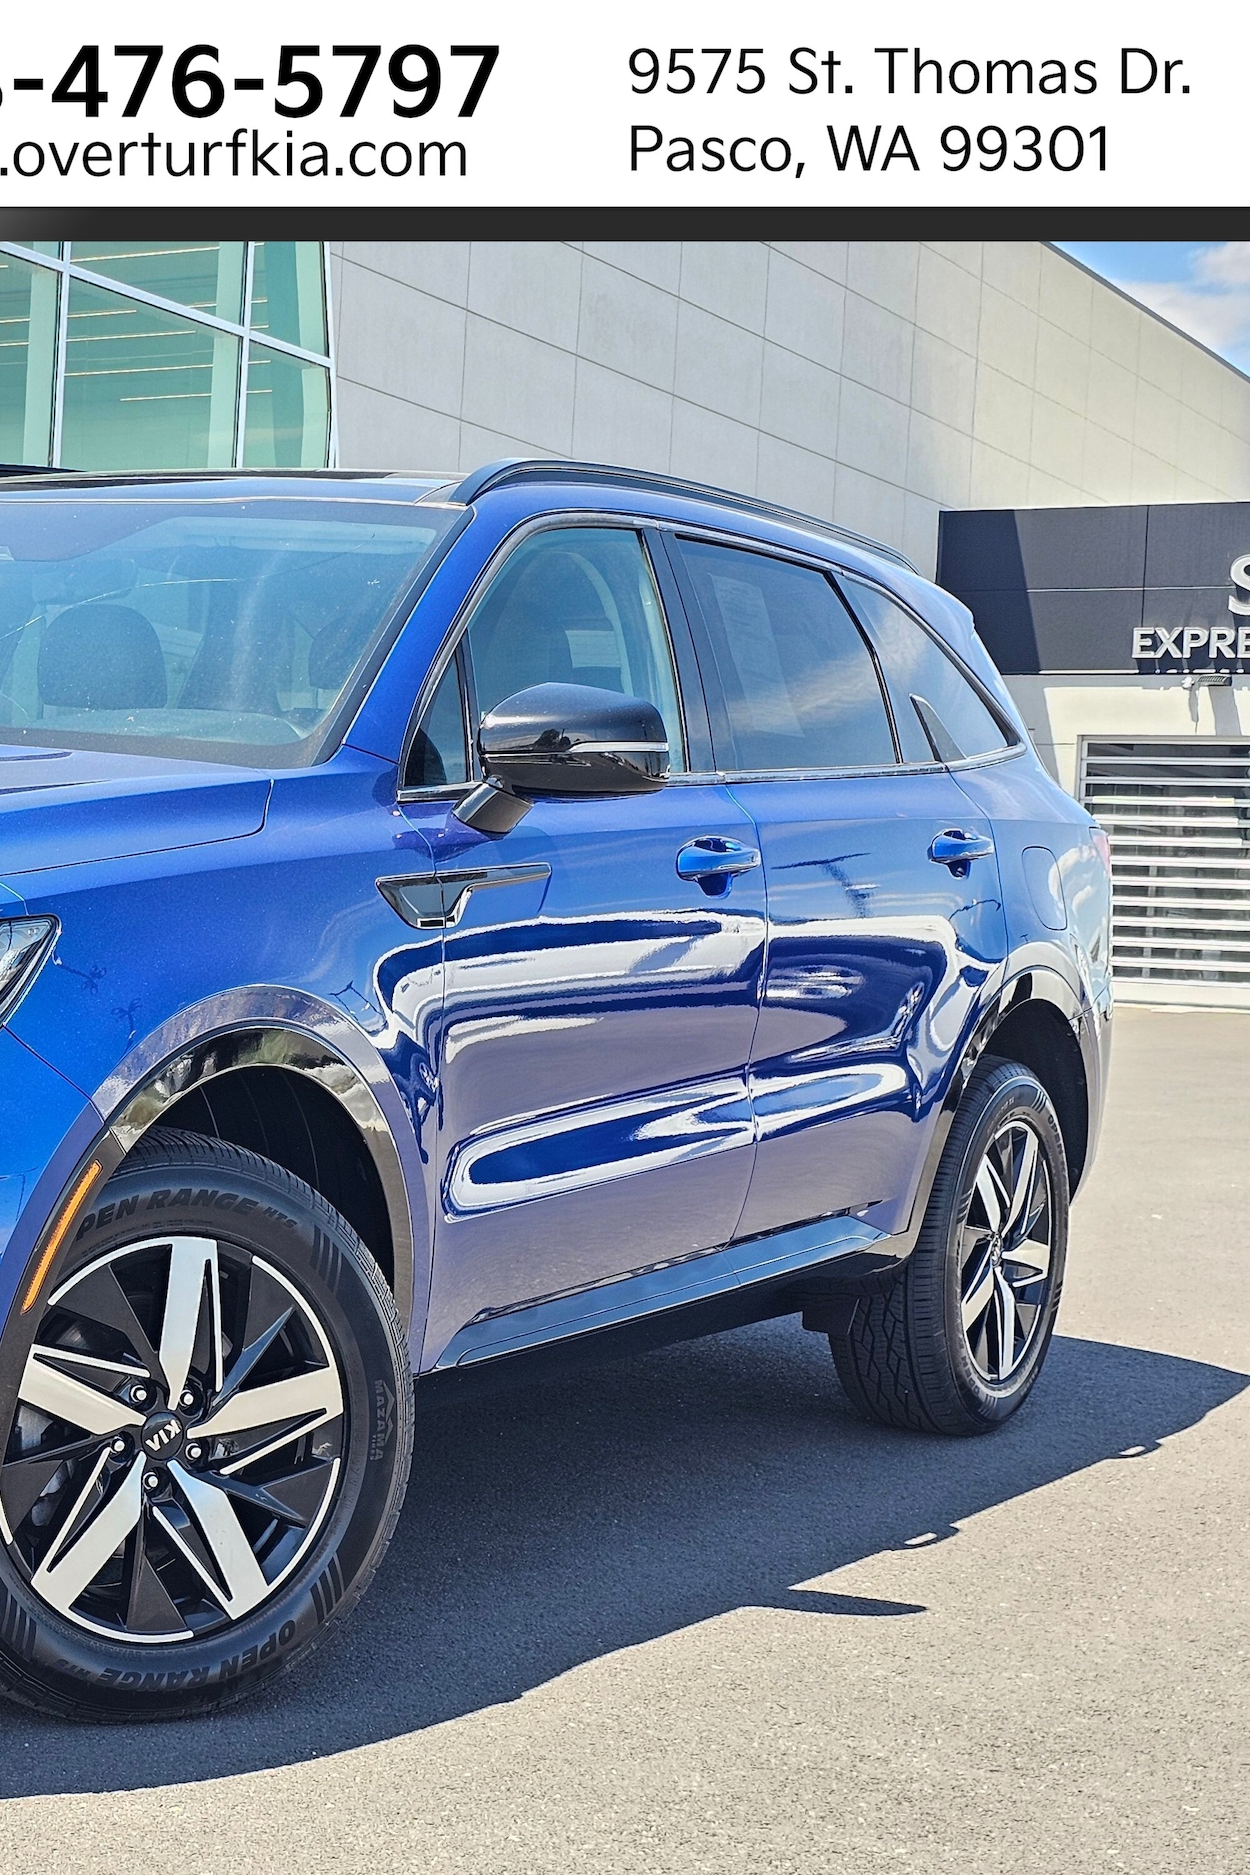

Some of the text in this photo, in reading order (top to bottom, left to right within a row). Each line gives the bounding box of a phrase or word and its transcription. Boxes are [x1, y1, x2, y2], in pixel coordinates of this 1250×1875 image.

[76, 1194, 140, 1241] PEN
[146, 1188, 260, 1216] RANGE
[145, 1419, 181, 1451] KIA
[375, 1380, 386, 1460] MAZAMA
[219, 1620, 296, 1675] OPEN
[99, 1666, 211, 1691] RANGE
